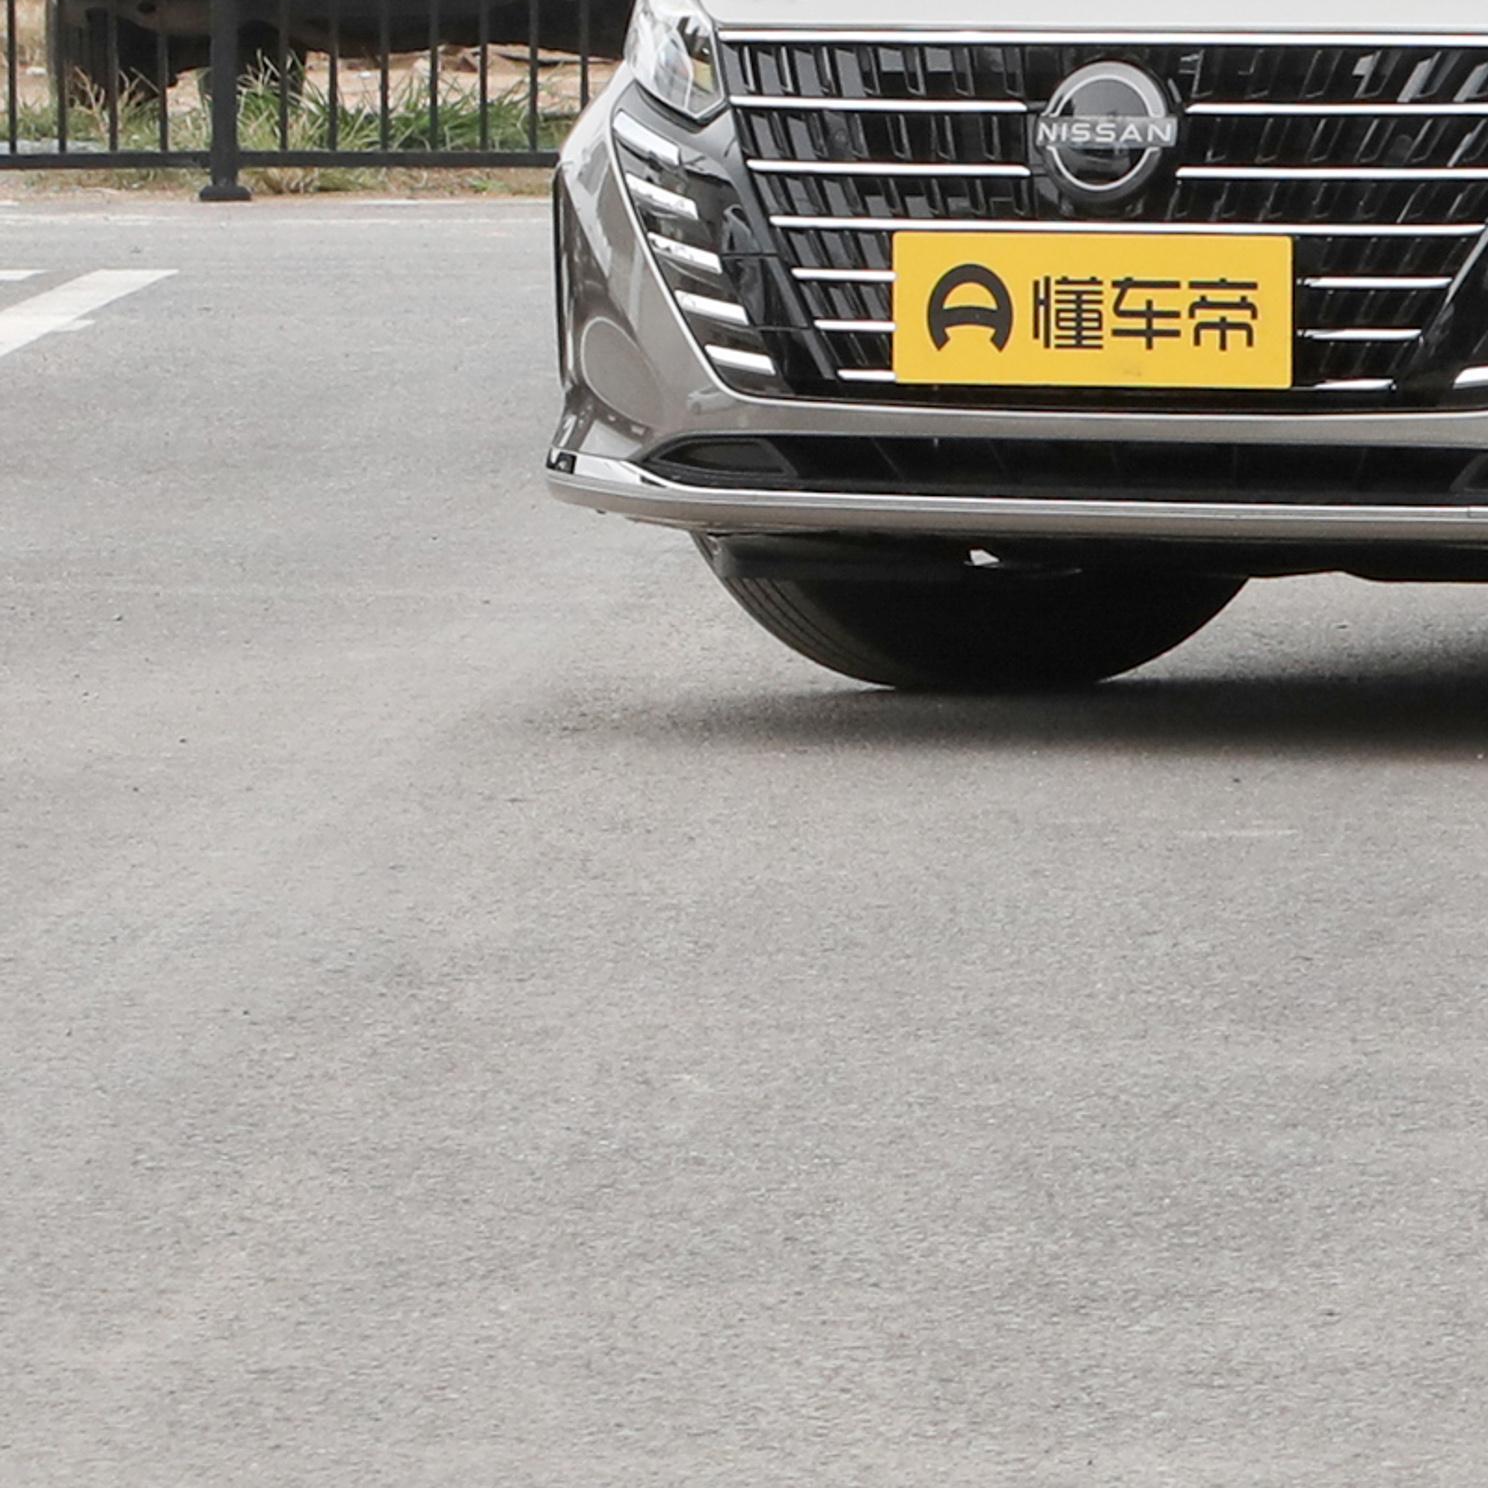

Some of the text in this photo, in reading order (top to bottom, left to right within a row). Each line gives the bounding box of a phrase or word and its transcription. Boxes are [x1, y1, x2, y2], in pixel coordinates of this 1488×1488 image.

[1037, 121, 1173, 143] NISSAN
[1032, 275, 1259, 352] 懂车帝
